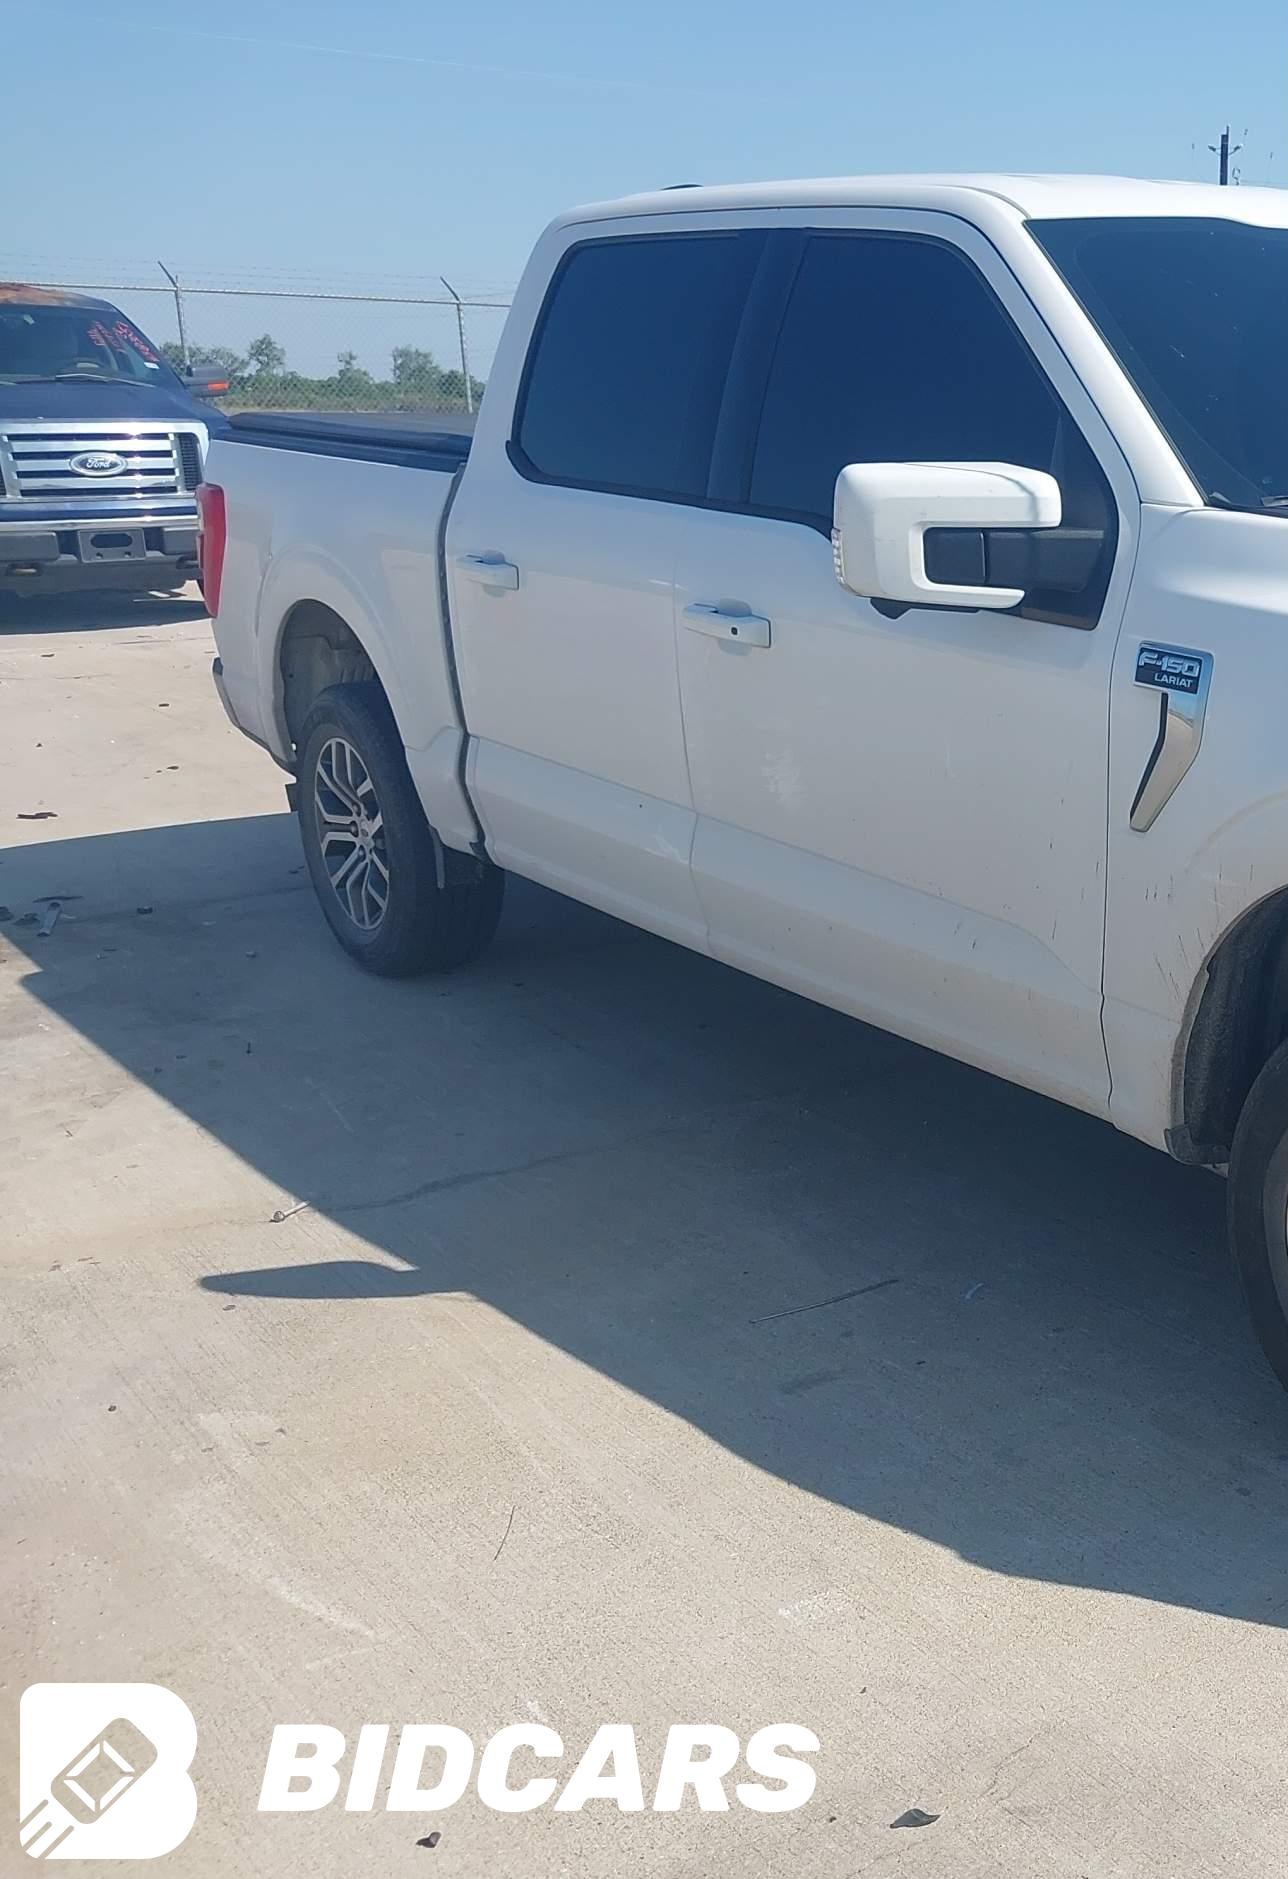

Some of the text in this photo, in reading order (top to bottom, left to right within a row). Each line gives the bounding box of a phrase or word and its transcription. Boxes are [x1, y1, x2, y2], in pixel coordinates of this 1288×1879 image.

[86, 456, 112, 468] Ford
[1138, 651, 1201, 677] F-150
[1154, 672, 1193, 688] LARIAT
